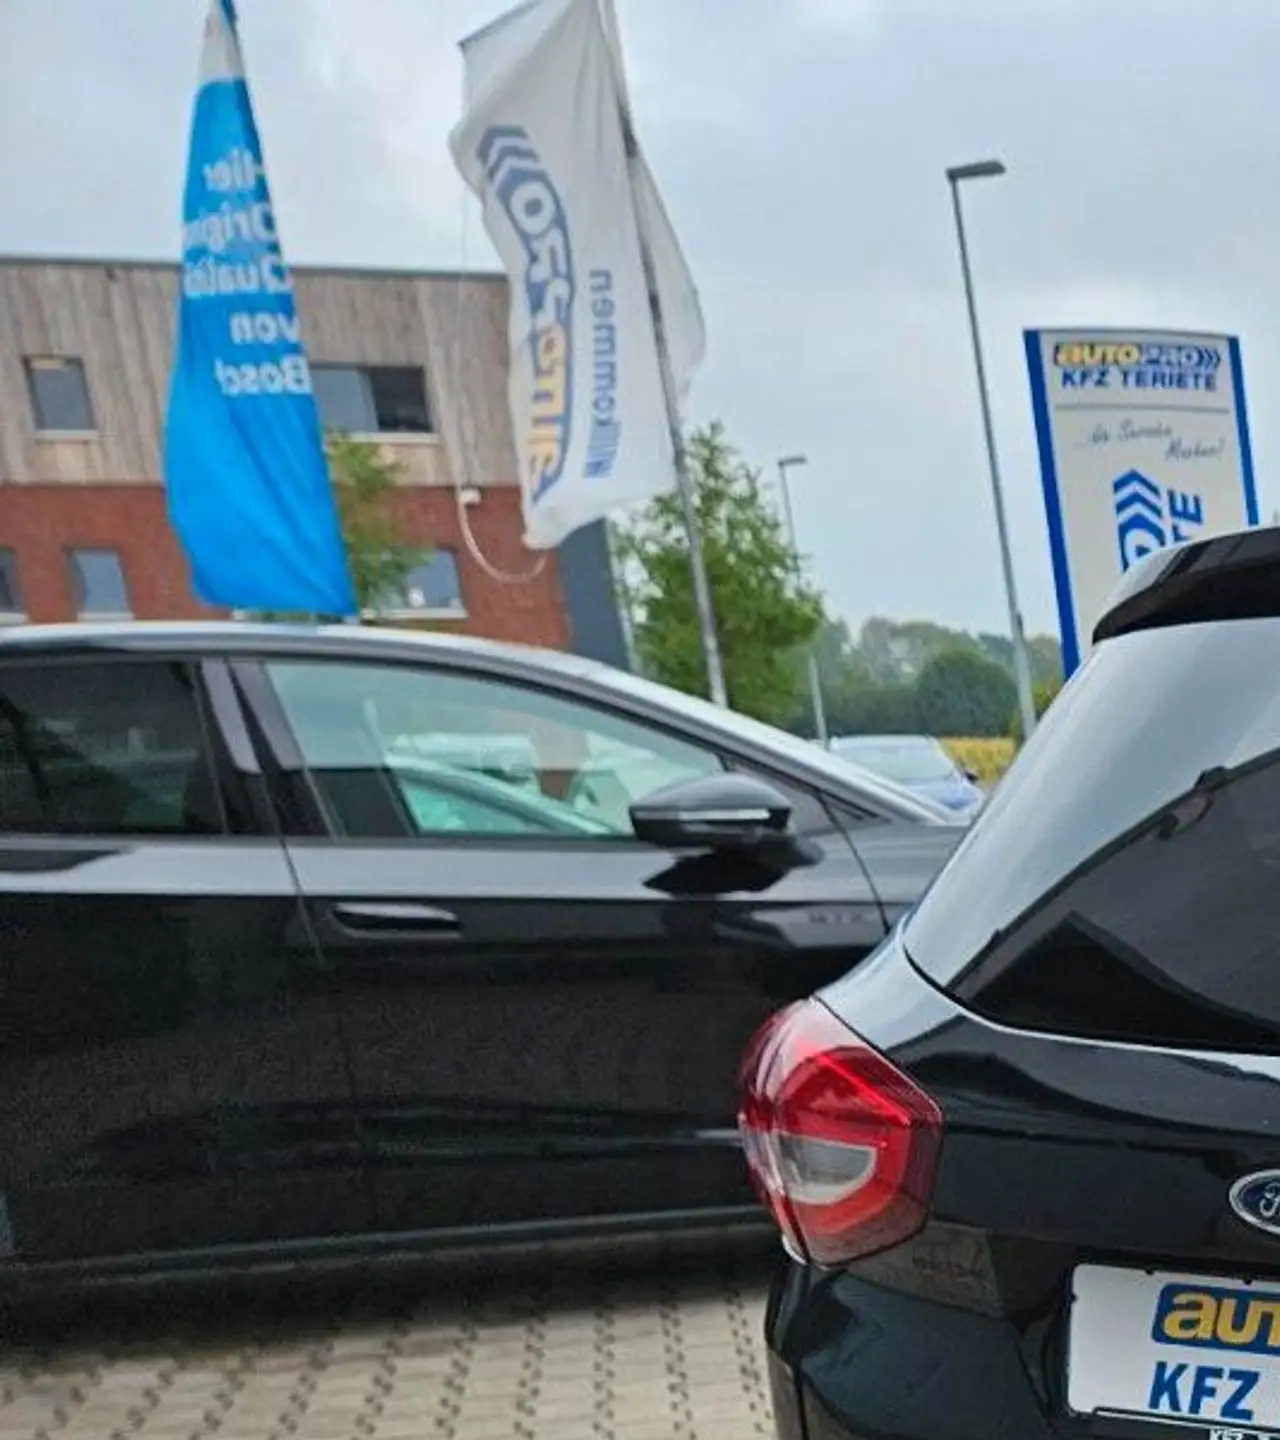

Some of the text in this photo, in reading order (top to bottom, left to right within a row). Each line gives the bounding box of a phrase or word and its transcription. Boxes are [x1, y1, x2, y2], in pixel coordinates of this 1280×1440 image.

[1062, 368, 1217, 391] KFZ TERIETE
[1147, 1360, 1260, 1421] KFZ
